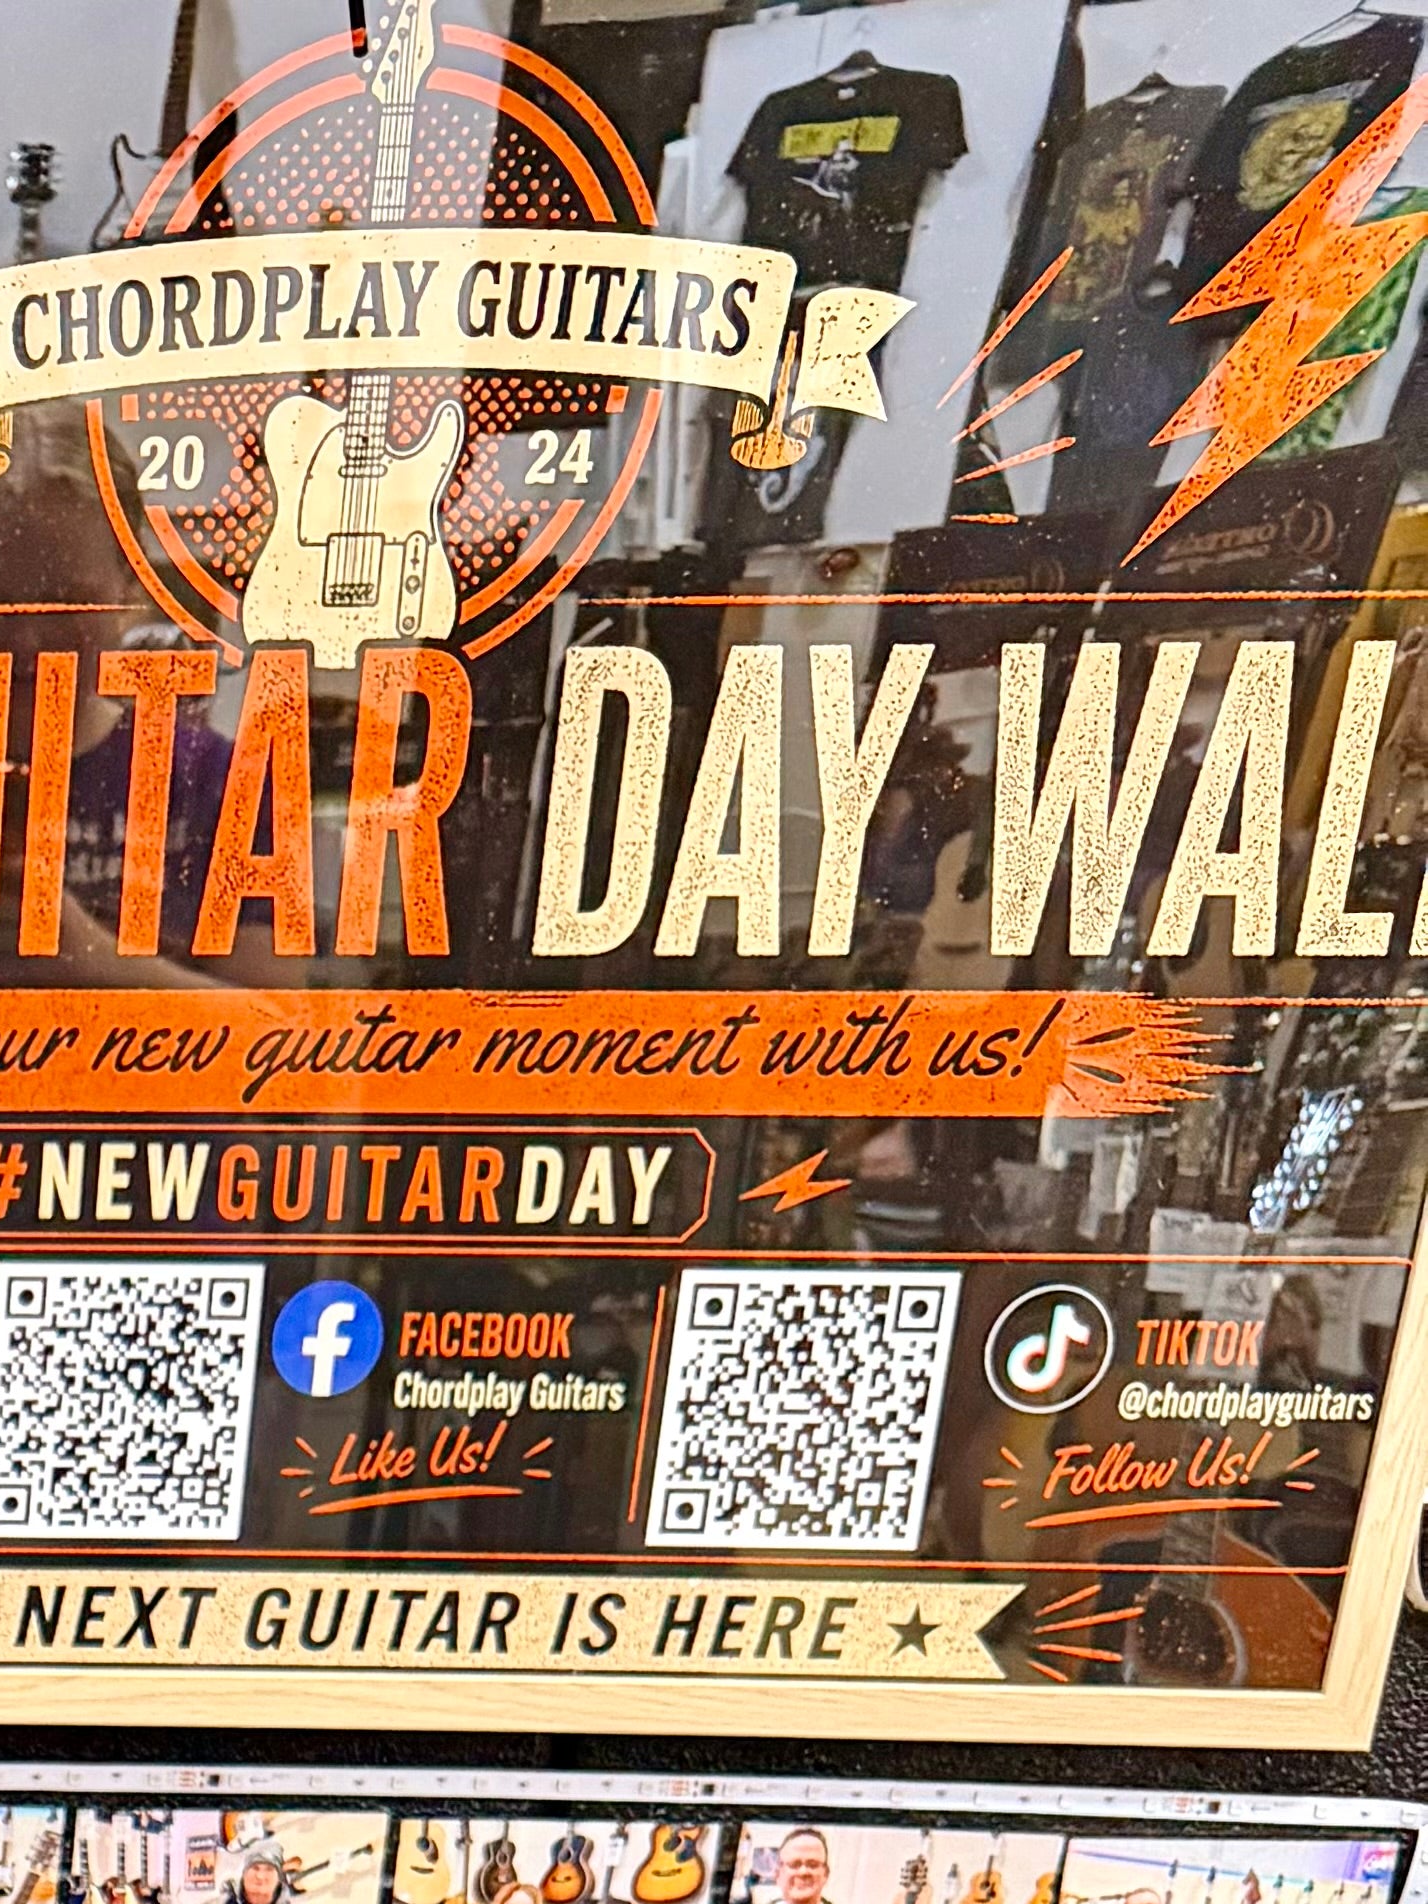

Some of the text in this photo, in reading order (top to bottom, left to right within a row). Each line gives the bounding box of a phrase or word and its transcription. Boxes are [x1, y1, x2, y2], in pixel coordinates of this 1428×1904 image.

[13, 260, 759, 370] CHORDPLAY GUITARS
[136, 429, 593, 491] 20 24
[531, 643, 935, 960] DAY
[988, 640, 1428, 957] WAL
[95, 1030, 230, 1075] new
[244, 1001, 460, 1103] guitar
[472, 1013, 756, 1077] moment
[763, 1000, 912, 1078] with
[927, 999, 1066, 1078] us!
[398, 1311, 575, 1360] FACEBOOK
[1136, 1319, 1265, 1368] TIKTOK
[393, 1371, 626, 1418] Chordplay Guitars
[1118, 1380, 1375, 1429] @chordplayguitars
[328, 1420, 508, 1486] Like Us!
[1042, 1431, 1274, 1500] Follow Us!
[14, 1583, 217, 1651] NEXT
[242, 1587, 522, 1653] GUITAR
[549, 1591, 627, 1656] IS
[651, 1594, 859, 1660] HERE
